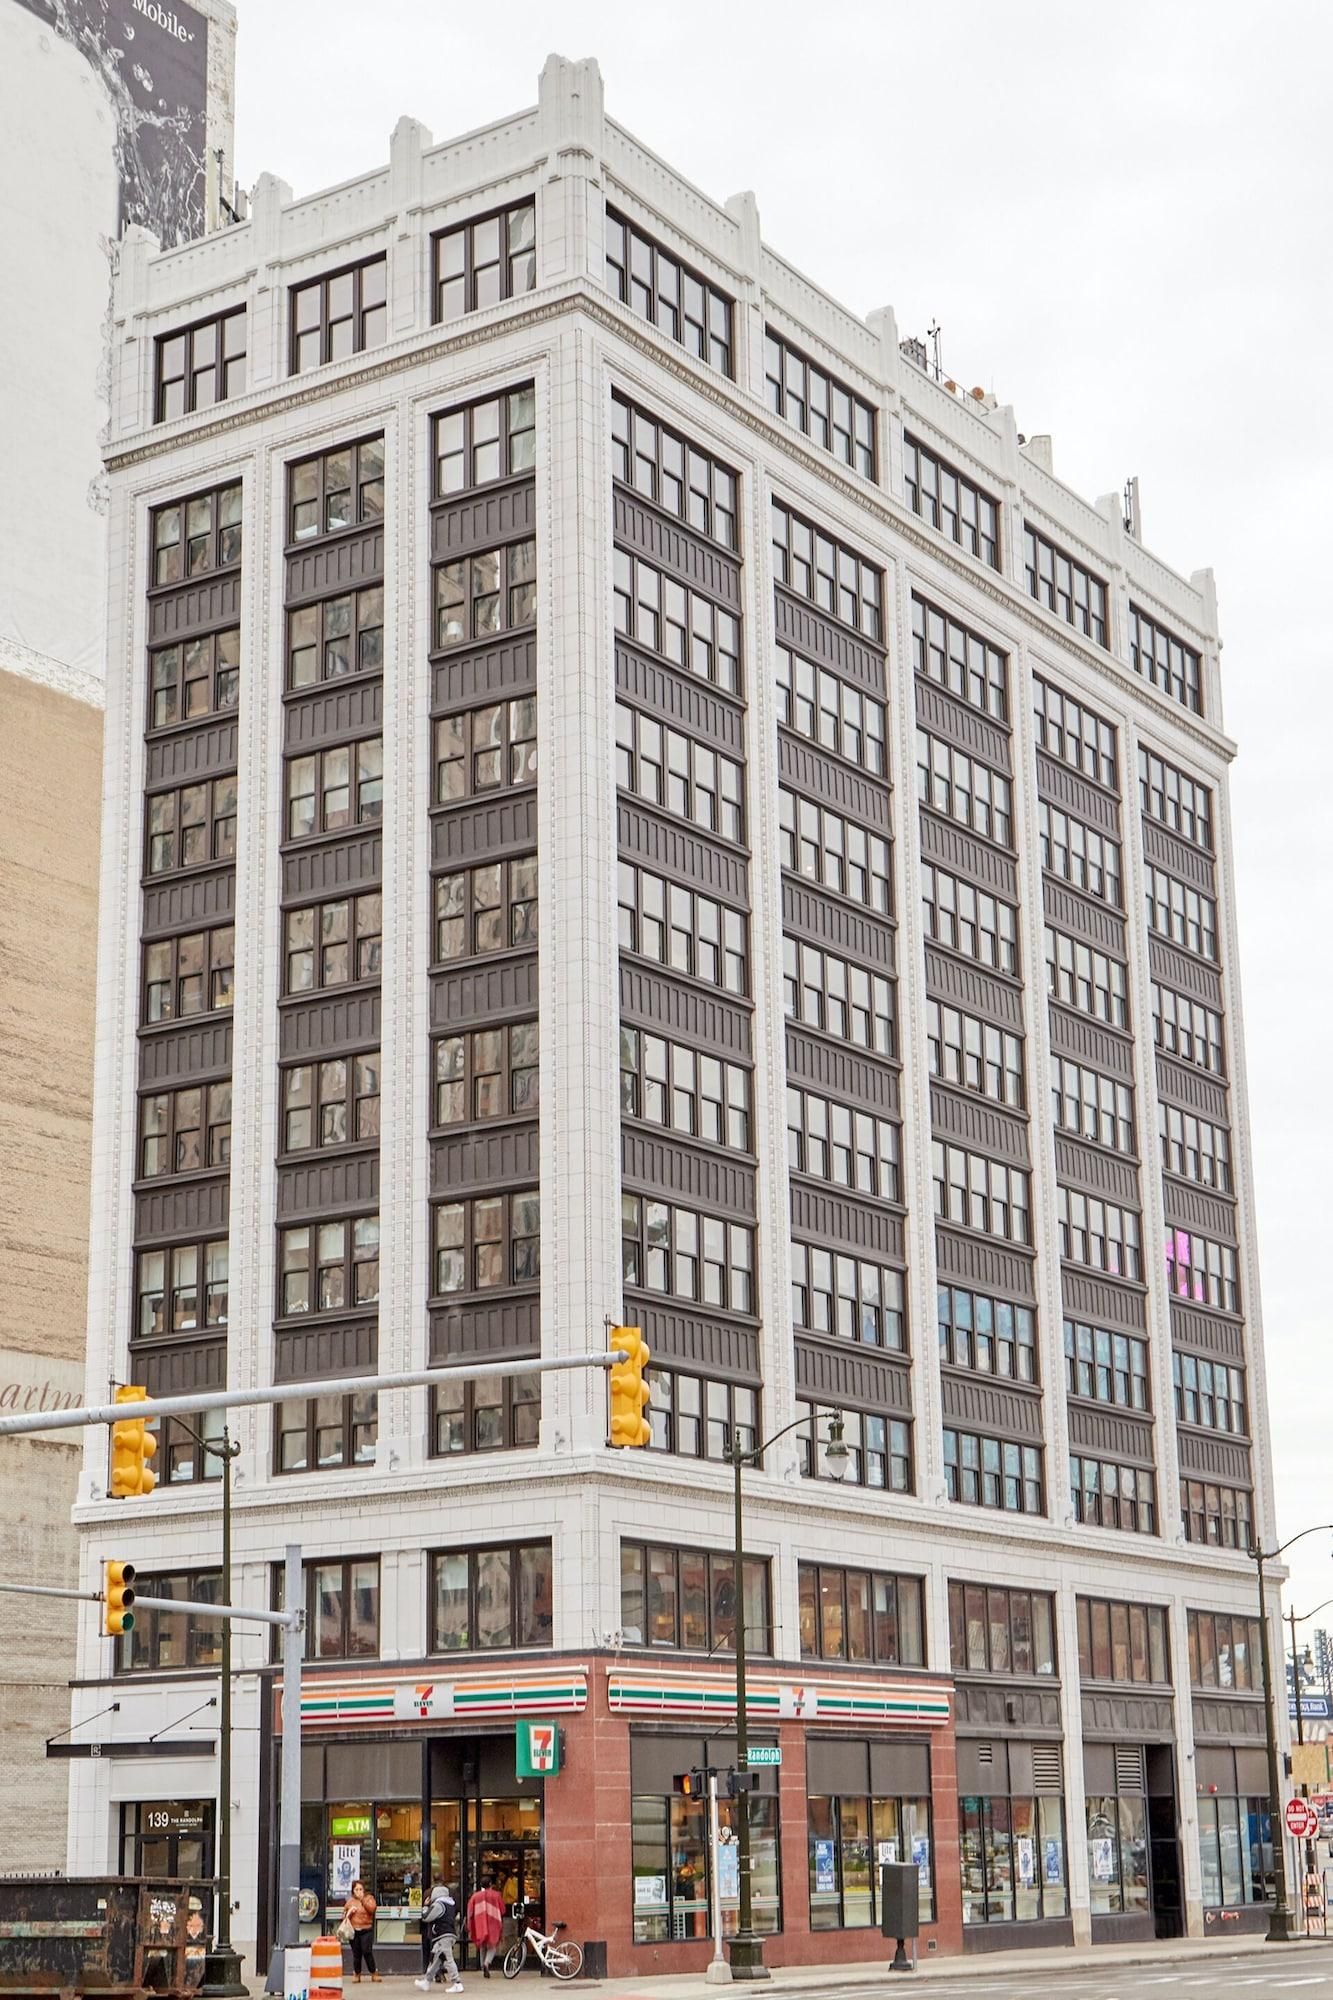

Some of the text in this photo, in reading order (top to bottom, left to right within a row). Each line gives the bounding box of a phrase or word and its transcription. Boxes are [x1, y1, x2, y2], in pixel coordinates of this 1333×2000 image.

[415, 1684, 433, 1716] 7
[534, 1730, 551, 1770] 7
[748, 1749, 780, 1763] Randolph
[1287, 1804, 1305, 1812] DO NOT
[147, 1812, 169, 1827] 139
[346, 1819, 370, 1832] ATM
[1290, 1821, 1304, 1830] ENTER
[338, 1846, 356, 1860] Lite
